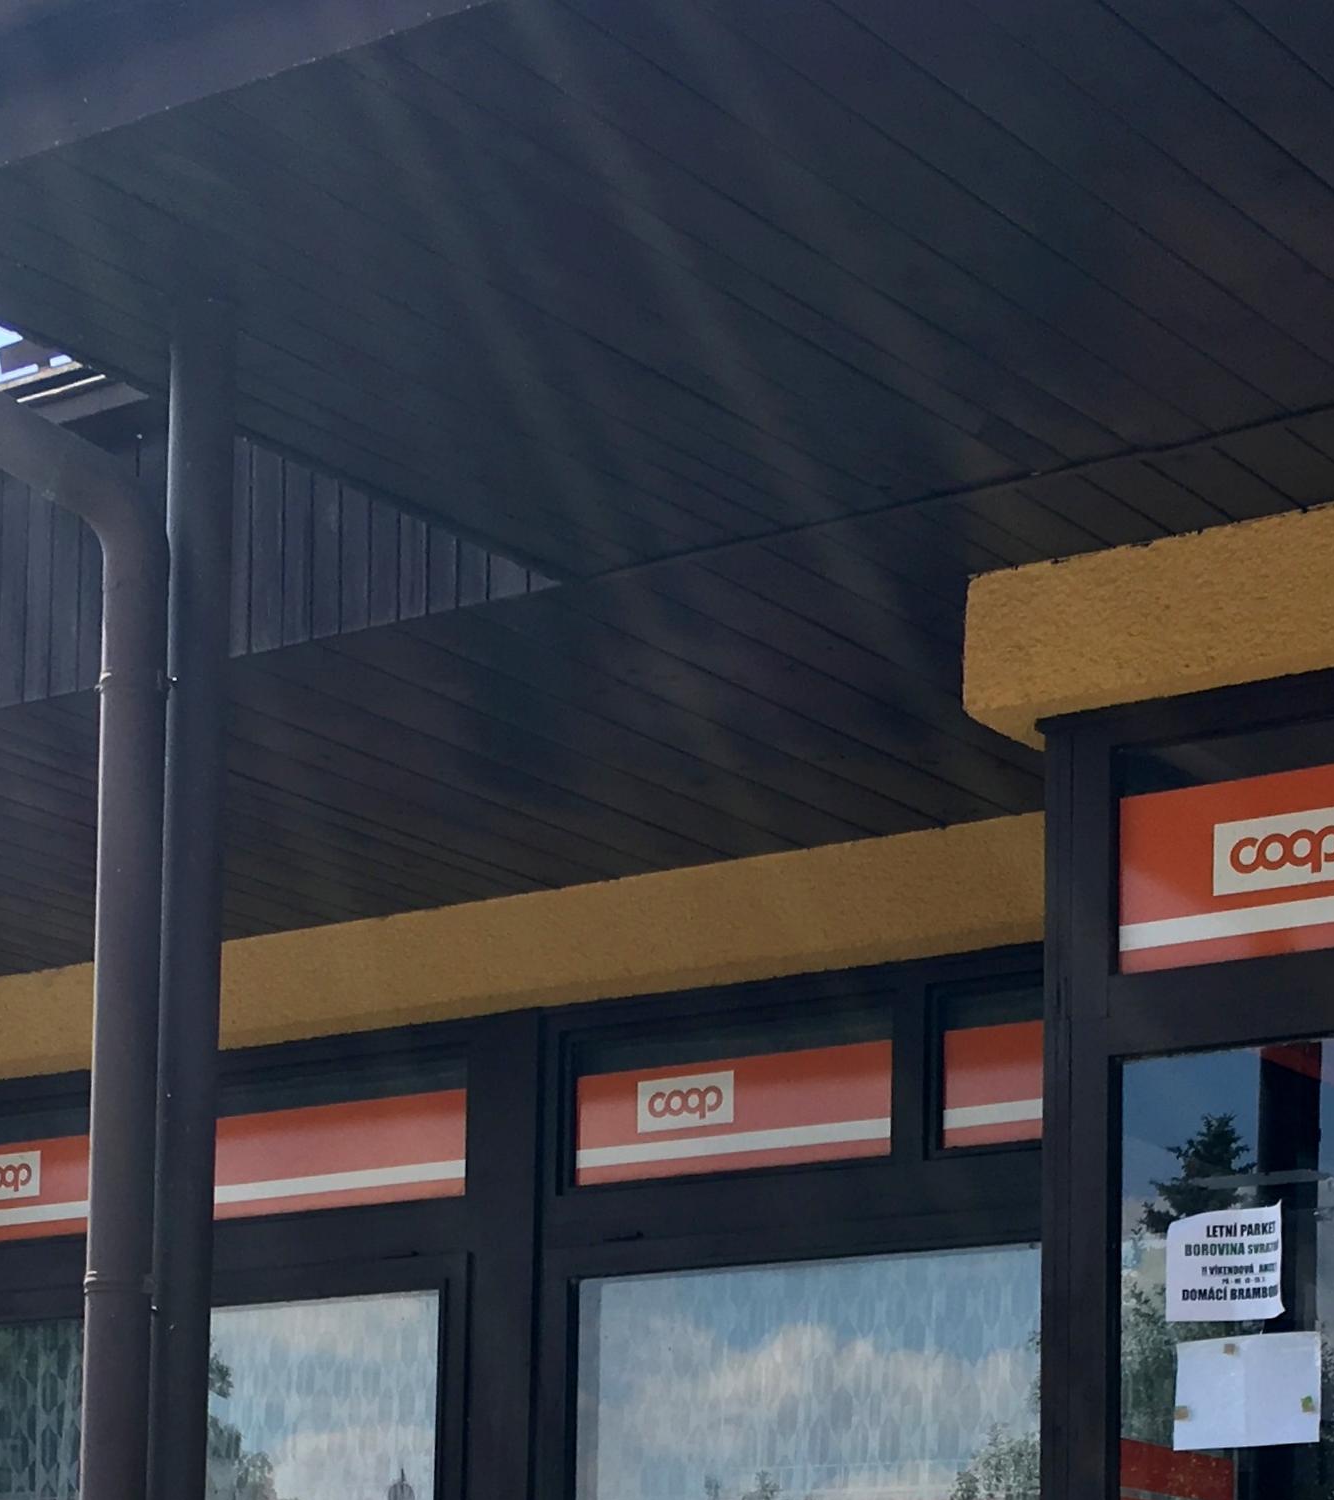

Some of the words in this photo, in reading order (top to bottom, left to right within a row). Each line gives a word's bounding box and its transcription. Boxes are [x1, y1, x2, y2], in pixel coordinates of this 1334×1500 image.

[647, 1085, 723, 1119] coop
[1206, 1222, 1237, 1238] LETNÍ
[1185, 1242, 1245, 1257] BOROVINA
[1182, 1286, 1227, 1301] DOMÁCÍ
